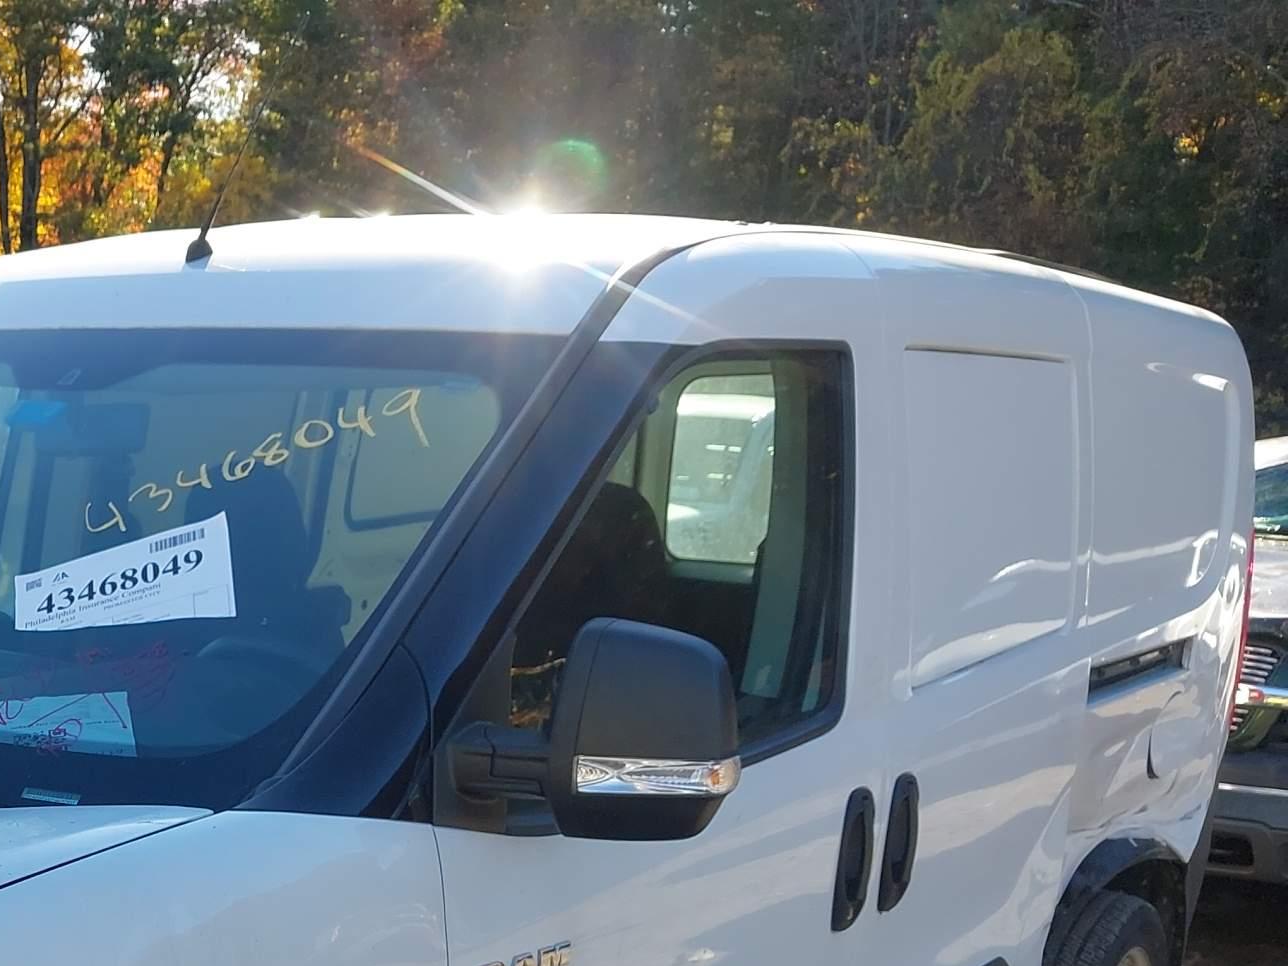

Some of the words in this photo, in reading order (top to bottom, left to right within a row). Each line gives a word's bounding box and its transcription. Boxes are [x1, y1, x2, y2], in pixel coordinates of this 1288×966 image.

[85, 388, 430, 533] 43468049
[24, 608, 77, 629] Philadelphia
[78, 595, 119, 611] Insurance
[37, 549, 204, 615] 43468049
